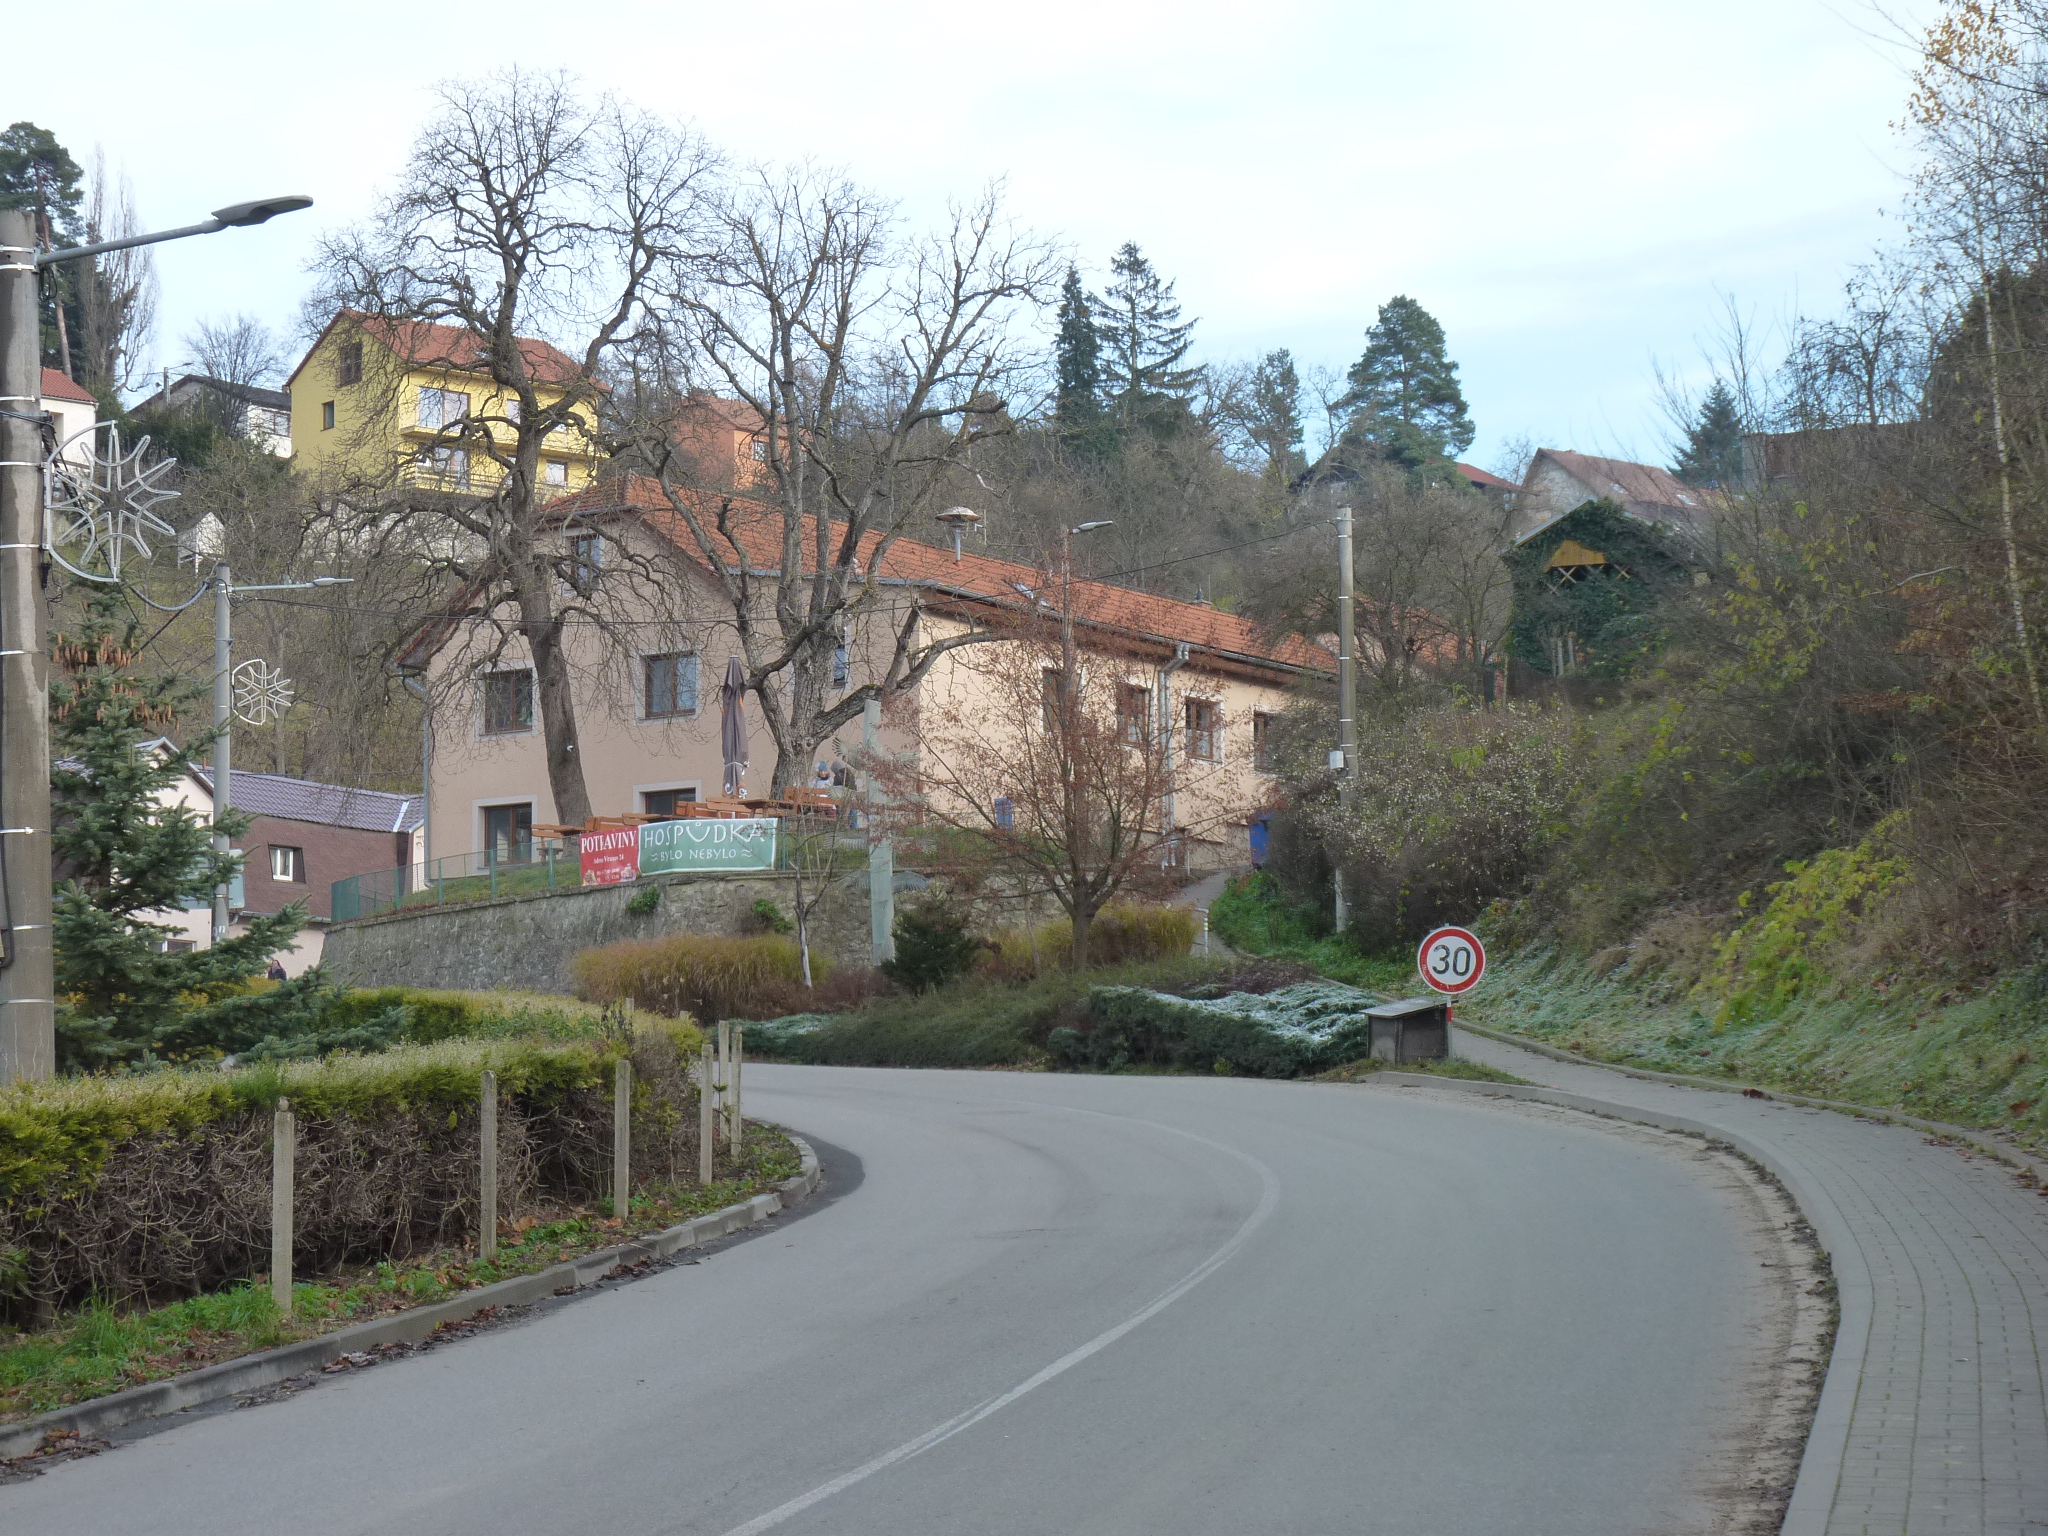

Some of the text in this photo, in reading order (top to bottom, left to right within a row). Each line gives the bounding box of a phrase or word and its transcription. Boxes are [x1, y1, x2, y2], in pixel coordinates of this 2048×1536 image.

[644, 821, 766, 849] HOSPŮDKA
[660, 848, 736, 862] BYLO NEBYLO
[1431, 944, 1471, 977] 30
